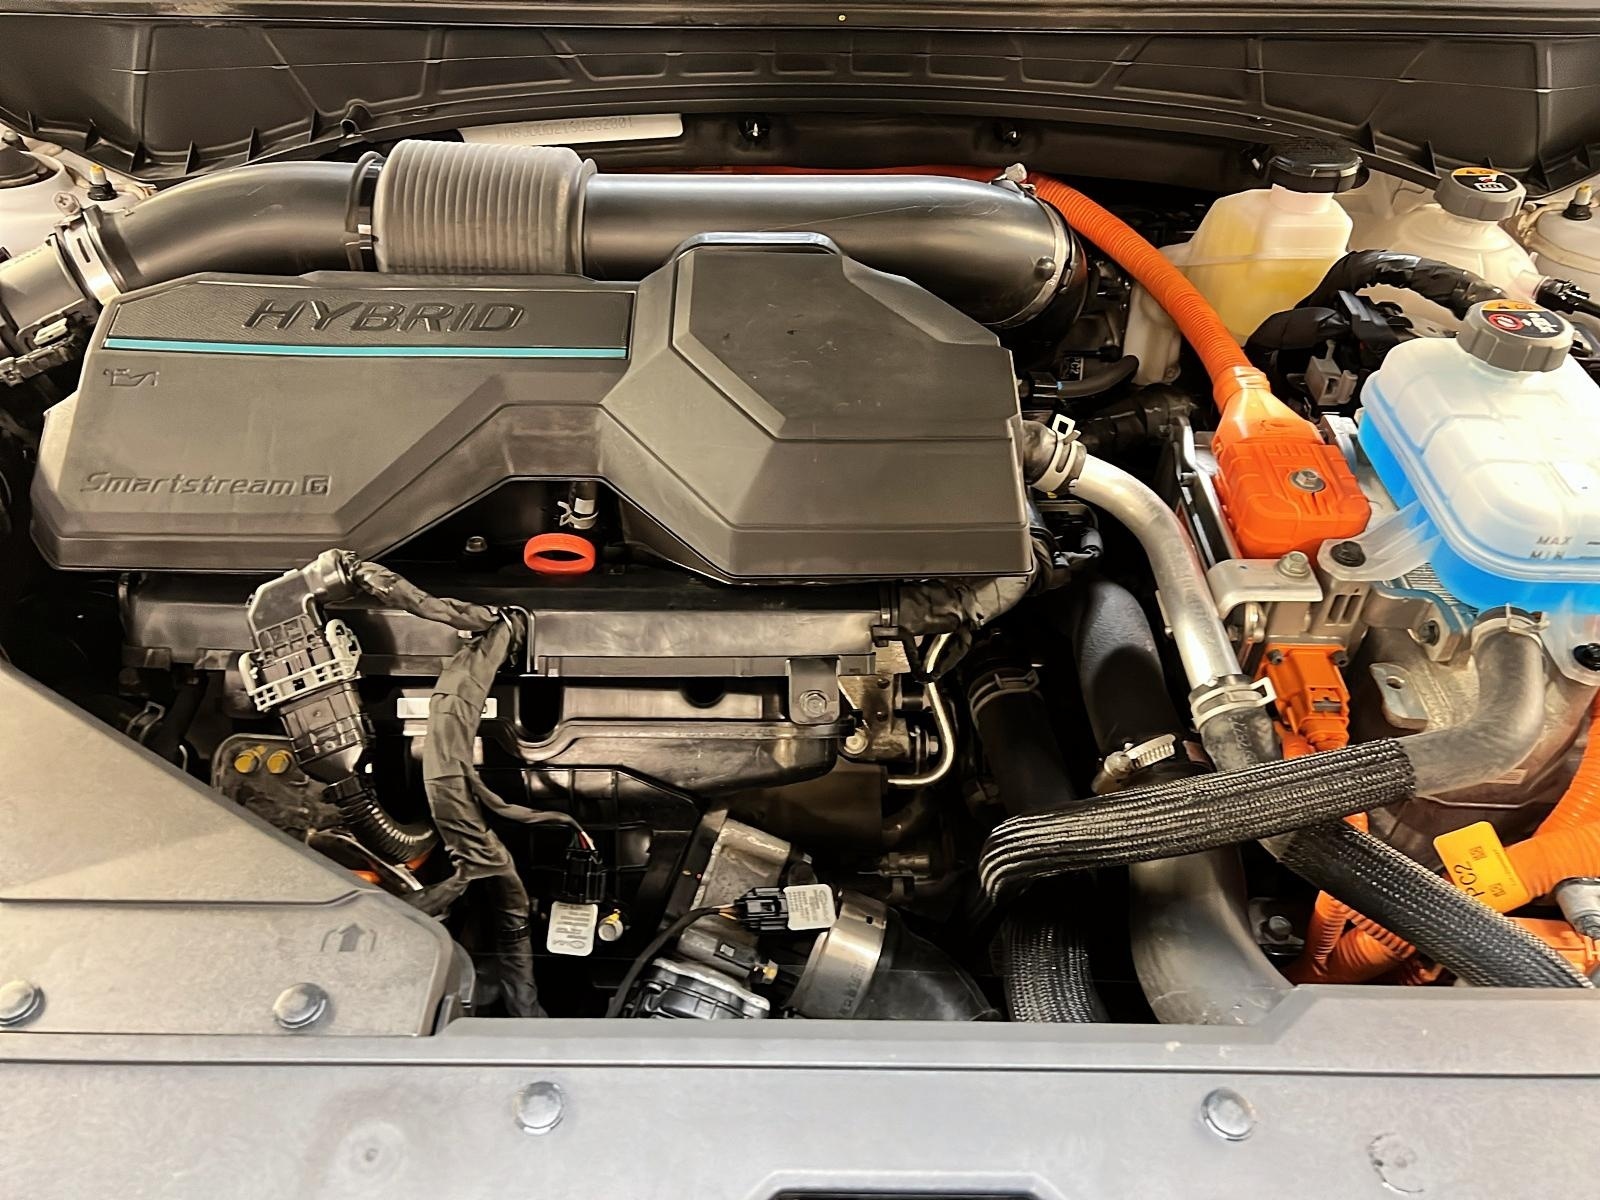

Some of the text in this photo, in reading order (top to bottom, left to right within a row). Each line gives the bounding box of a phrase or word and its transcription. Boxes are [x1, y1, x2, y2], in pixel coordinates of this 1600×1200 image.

[241, 300, 526, 332] HYBRID
[79, 472, 331, 496] Smartstream G
[1536, 536, 1573, 545] MAX
